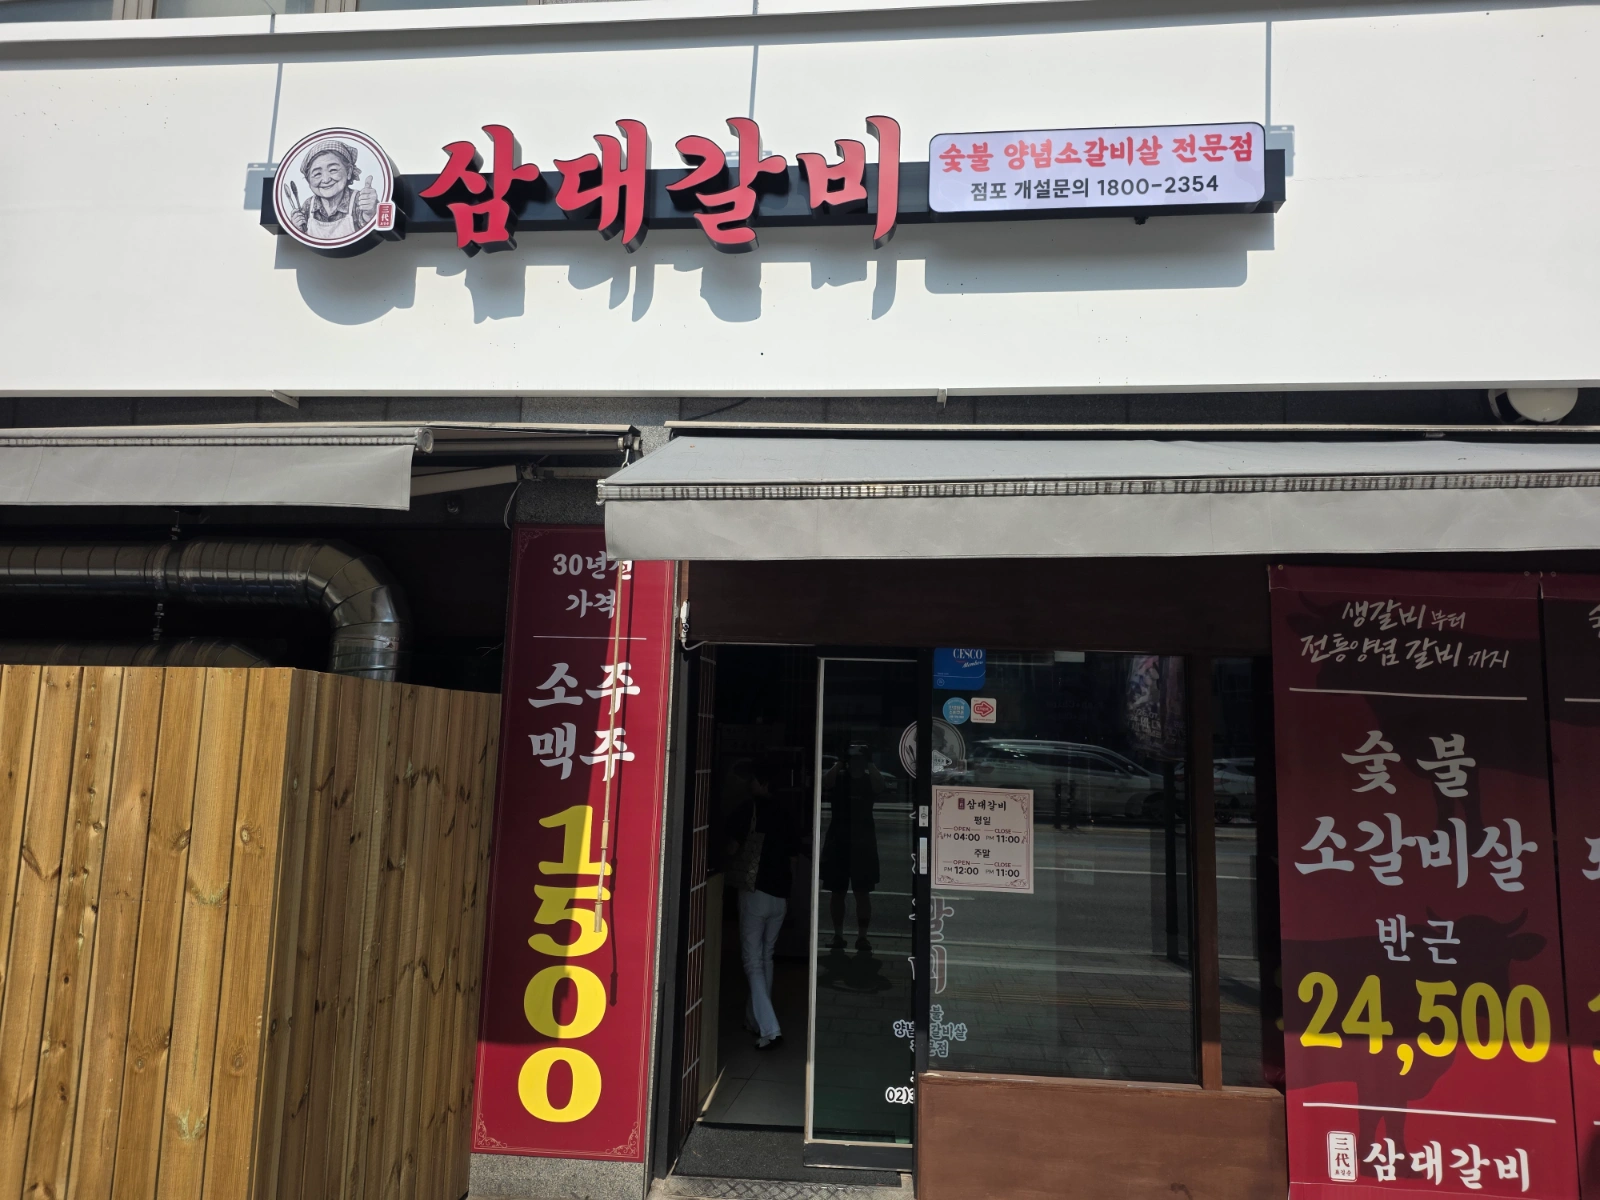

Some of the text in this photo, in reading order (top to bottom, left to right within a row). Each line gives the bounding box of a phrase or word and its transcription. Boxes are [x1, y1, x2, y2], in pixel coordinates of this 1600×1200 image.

[938, 132, 1253, 173] 숯불 양념소갈비살 전문점
[419, 115, 901, 250] 삼대갈비
[970, 175, 1219, 201] 점포 개설문의 1800-2354
[565, 588, 616, 619] 가격
[1341, 599, 1466, 631] 생갈비 부터
[952, 648, 983, 659] CESCO
[1404, 637, 1463, 669] 갈비
[1468, 649, 1510, 668] 까지
[528, 661, 641, 715] 소주
[528, 722, 636, 781] 맥주
[967, 799, 1007, 811] 삼대갈비
[974, 816, 991, 825] 평일
[953, 833, 980, 841] 04:00
[996, 835, 1020, 843] 11:00
[1294, 812, 1538, 892] 소갈비살
[974, 849, 990, 858] 주말
[954, 866, 979, 875] 12:00
[996, 869, 1020, 877] 11:00
[518, 805, 613, 1123] 1500
[1298, 971, 1551, 1076] 24,500
[1334, 1137, 1351, 1167] 三代
[1363, 1137, 1531, 1193] 삼대갈비
